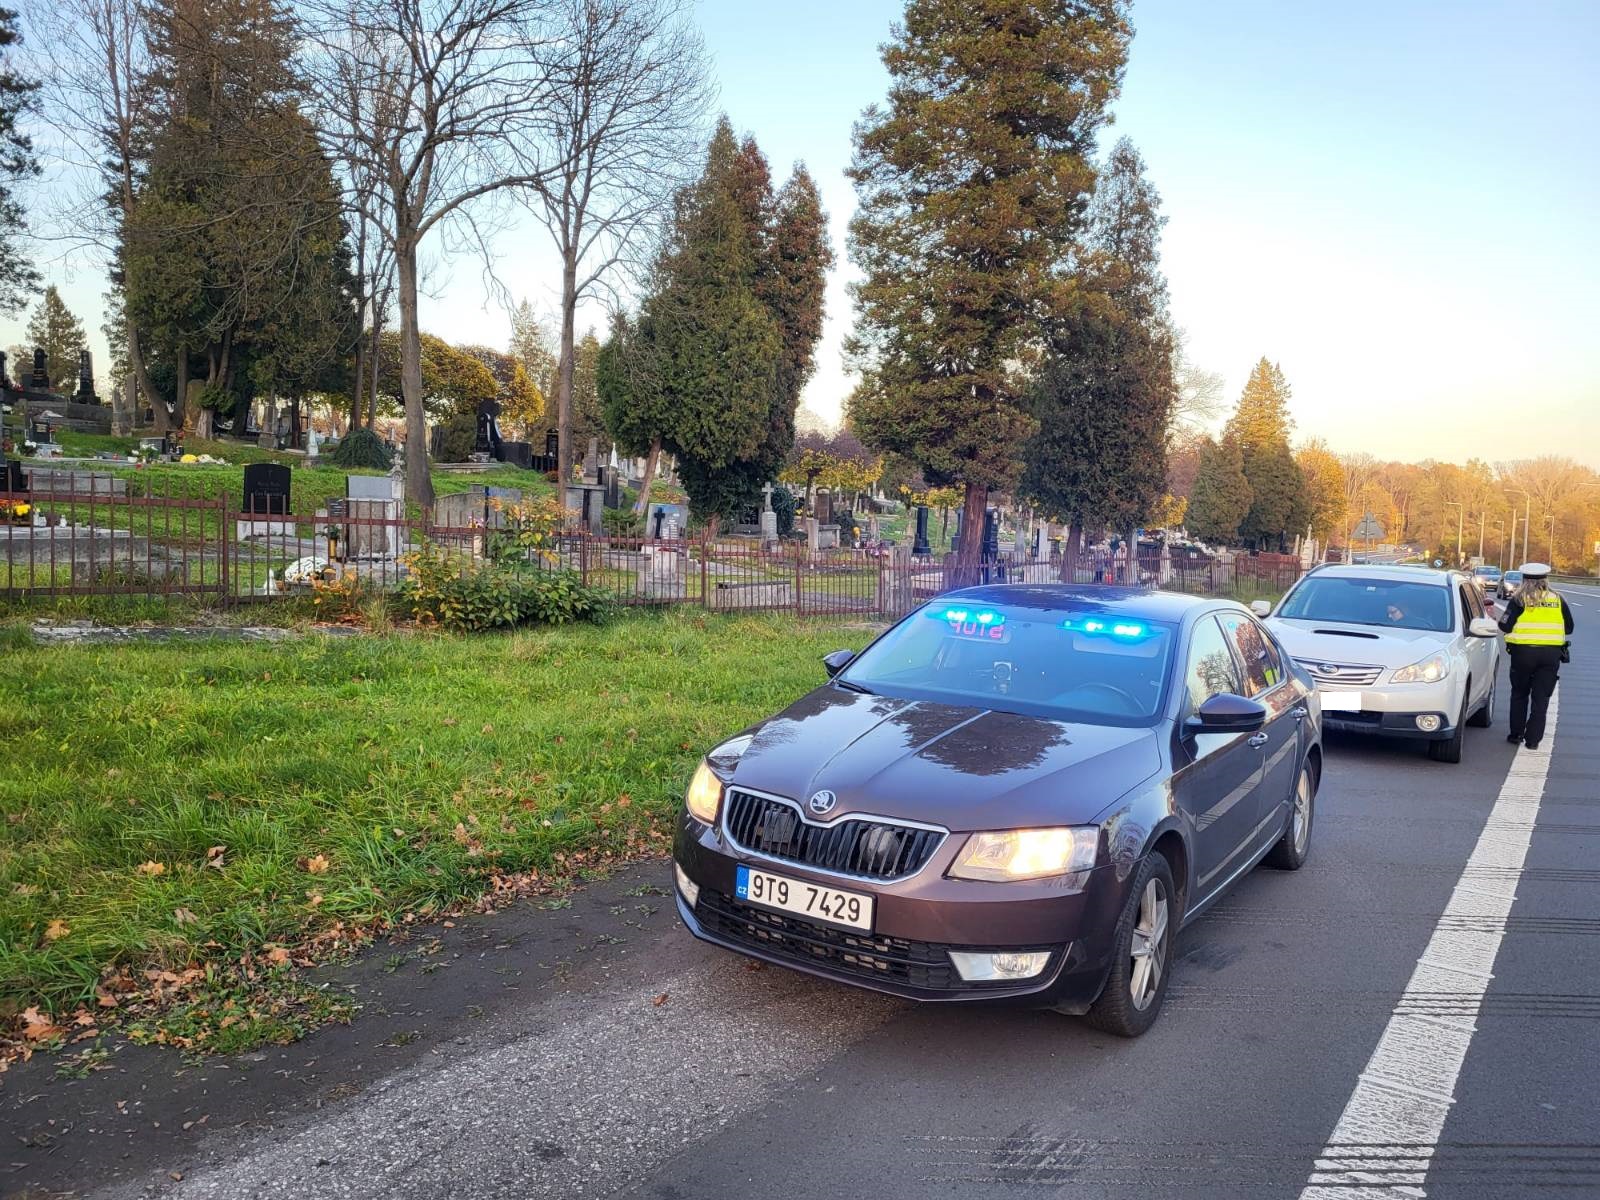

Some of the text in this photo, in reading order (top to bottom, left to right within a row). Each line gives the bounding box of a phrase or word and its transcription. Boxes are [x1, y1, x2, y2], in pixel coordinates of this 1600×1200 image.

[737, 886, 747, 895] CZ
[753, 874, 861, 923] 9T9 7429
